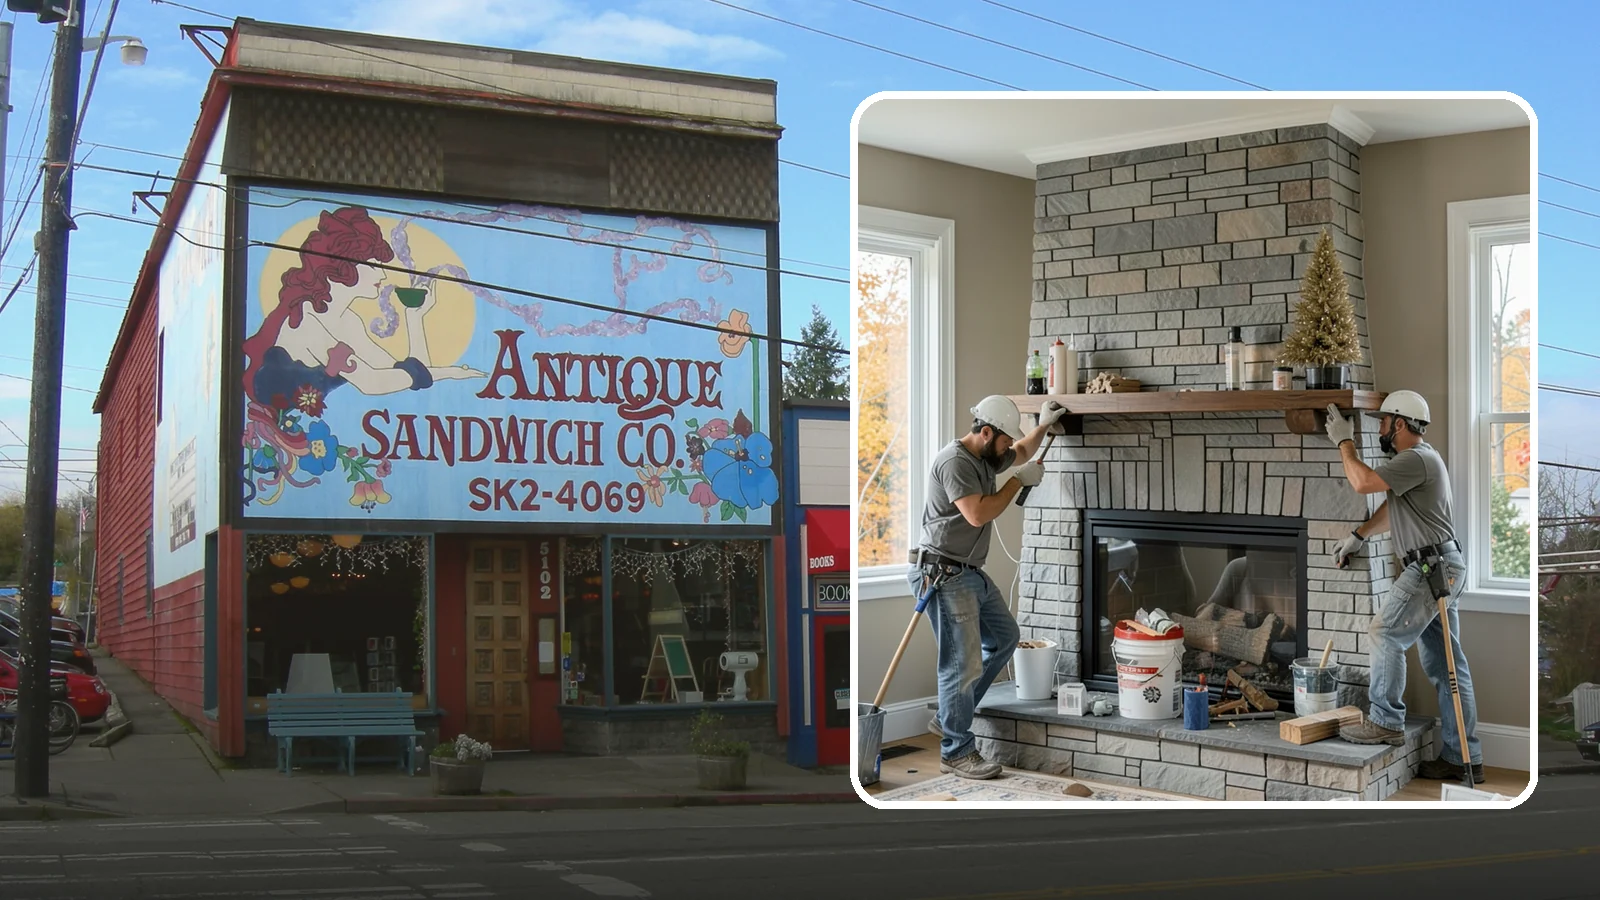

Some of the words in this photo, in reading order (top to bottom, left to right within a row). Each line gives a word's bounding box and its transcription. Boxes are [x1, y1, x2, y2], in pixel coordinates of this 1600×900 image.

[475, 329, 723, 420] ANTIQUE
[361, 408, 605, 467] SANDWICH
[617, 422, 685, 468] CO.
[468, 478, 646, 514] SK2-4069
[540, 542, 551, 599] 5102
[809, 555, 835, 569] BOOKS
